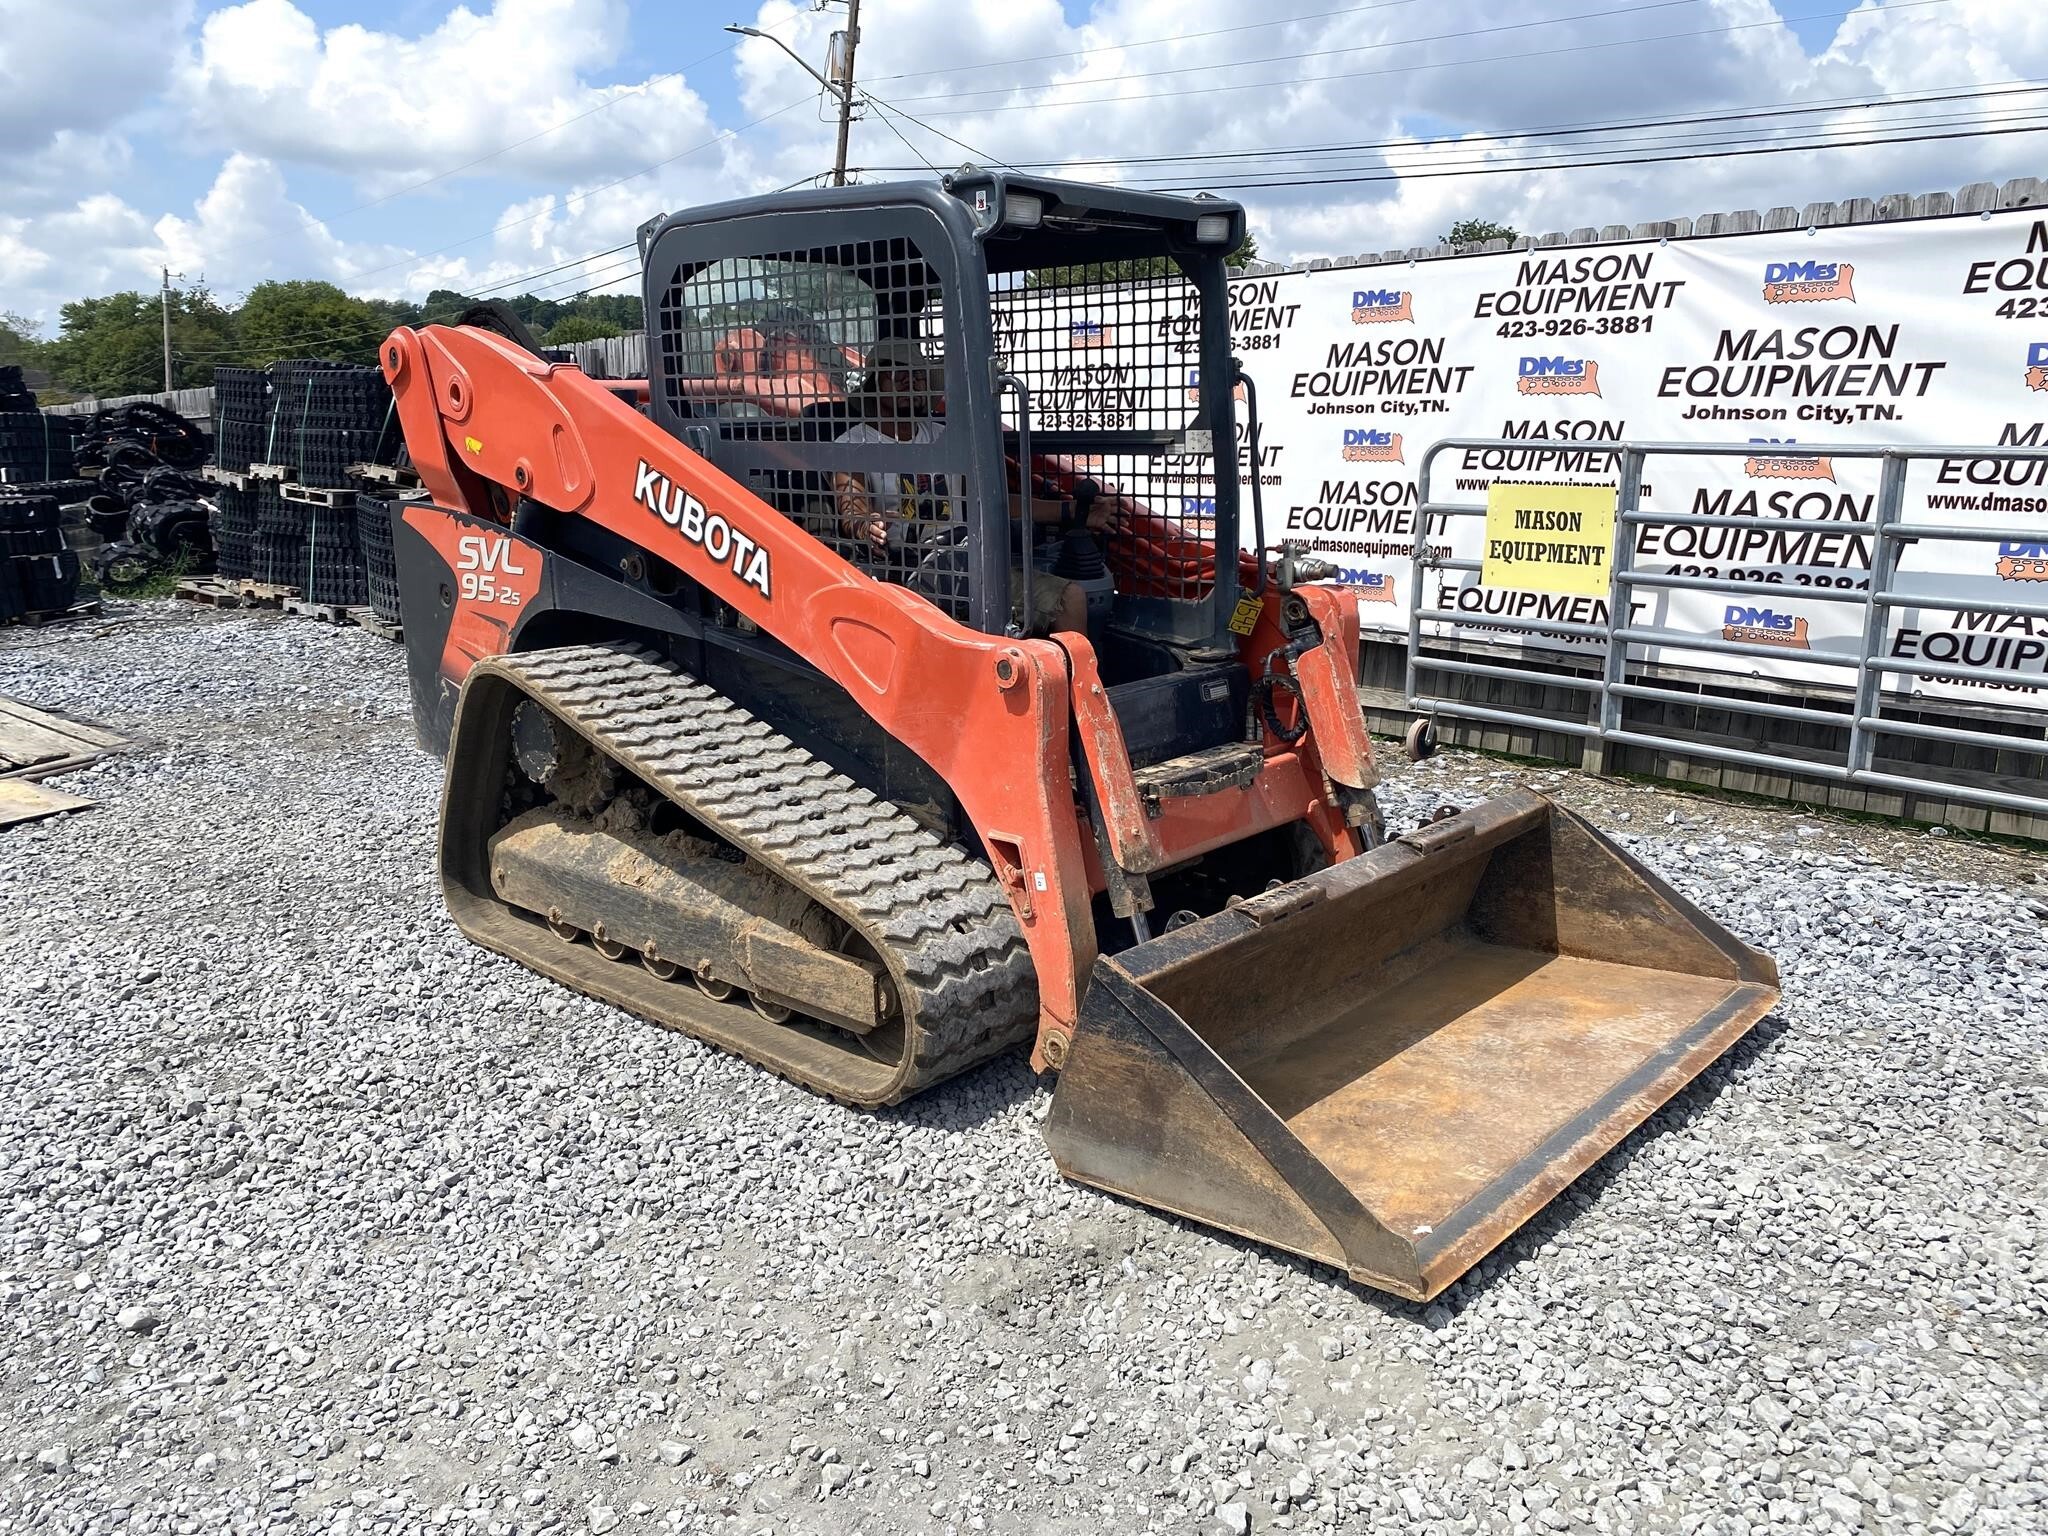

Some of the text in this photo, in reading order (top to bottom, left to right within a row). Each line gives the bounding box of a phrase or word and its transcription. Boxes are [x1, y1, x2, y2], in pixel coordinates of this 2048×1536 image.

[1516, 252, 1653, 287] MASON
[1474, 281, 1686, 318] EQUIPMENT
[1157, 304, 1301, 337] EQUMENT
[1496, 315, 1653, 338] 423-926-3881
[1326, 337, 1445, 368] MASON
[1713, 323, 1900, 361] MASON
[1290, 366, 1475, 398] EQUIPMENT
[1657, 361, 1947, 398] EQUIPMENT
[1307, 402, 1375, 415] Johnson
[1682, 404, 1788, 421] Johnson
[1502, 420, 1625, 441] MASON
[1462, 448, 1622, 473] EQUIPMEN
[1514, 509, 1582, 532] MASON
[1691, 488, 1875, 522] MASON
[634, 459, 772, 598] KUBOTA
[457, 536, 524, 575] SVL
[1489, 540, 1605, 566] EQUIPMENT
